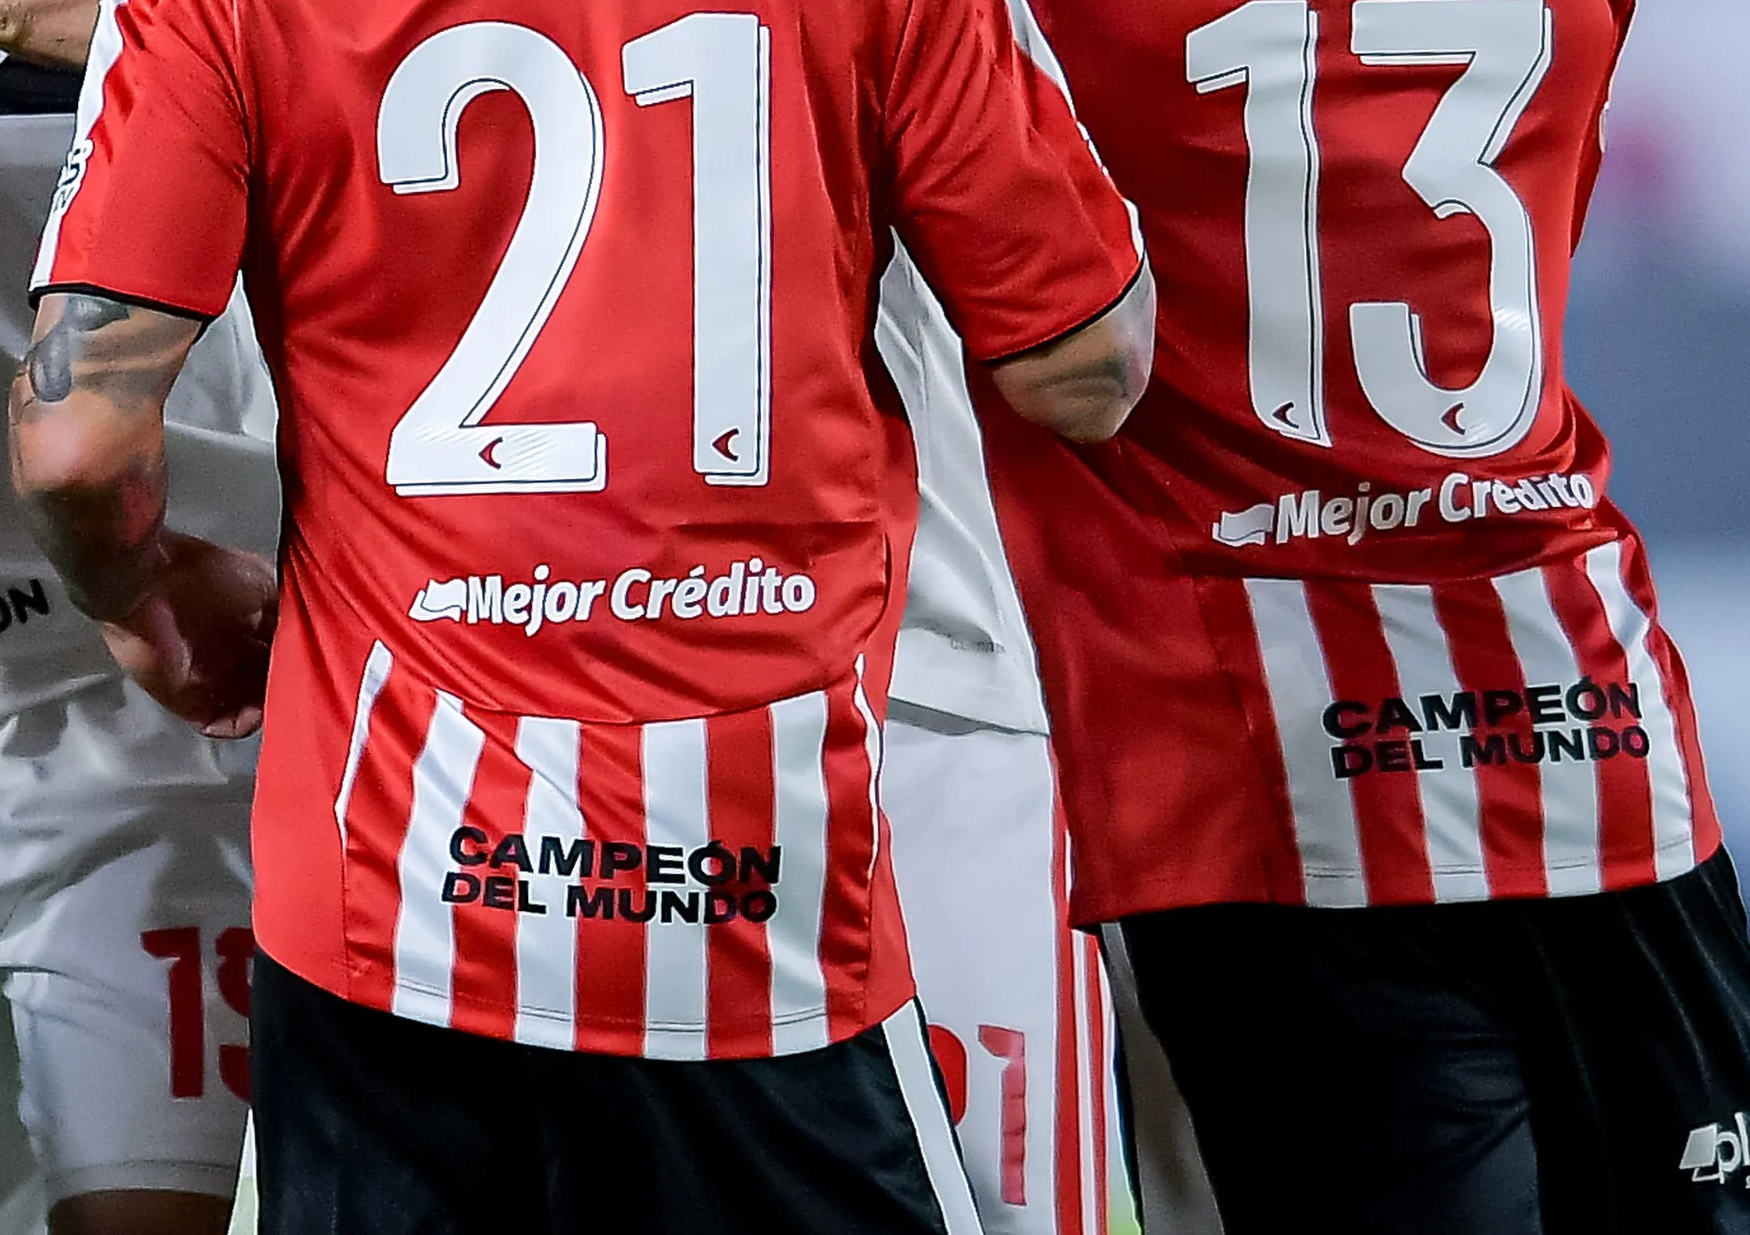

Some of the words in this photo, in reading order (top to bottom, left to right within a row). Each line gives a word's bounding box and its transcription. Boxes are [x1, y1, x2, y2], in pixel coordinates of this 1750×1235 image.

[376, 13, 771, 496] 21
[1276, 479, 1432, 546] Mejor
[1436, 472, 1596, 524] Crédito
[465, 565, 605, 636] Mejor
[610, 558, 816, 621] Crédito
[1322, 676, 1643, 740] CAMPEÓN
[1330, 739, 1444, 780] DEL
[1460, 725, 1651, 769] MUNDO
[449, 825, 782, 886] CAMPEÓN
[441, 871, 547, 914] DEL
[565, 885, 778, 924] MUNDO
